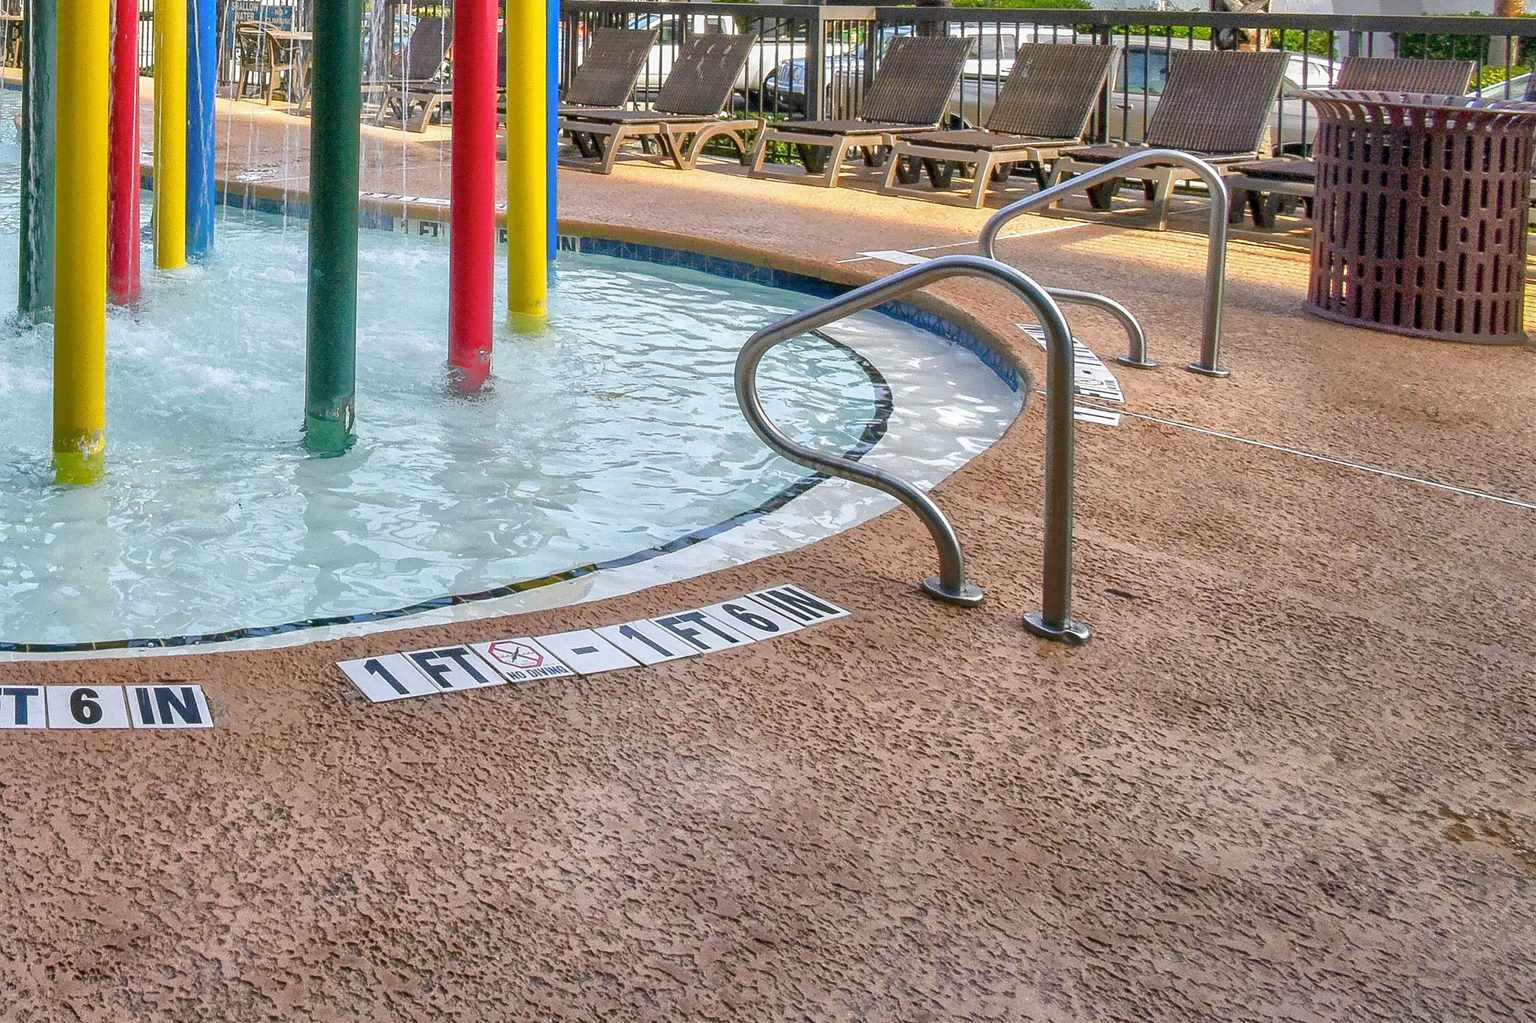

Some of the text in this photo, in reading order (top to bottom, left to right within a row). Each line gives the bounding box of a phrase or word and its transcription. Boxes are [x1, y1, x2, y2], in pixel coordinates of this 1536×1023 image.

[364, 659, 409, 695] 1
[409, 647, 489, 689] FT
[619, 624, 674, 657] 1
[655, 611, 740, 650] FT
[721, 603, 780, 632] 6
[755, 586, 841, 622] IN
[507, 665, 569, 680] NO DIVING
[70, 687, 103, 725] 6
[134, 686, 204, 725] IN
